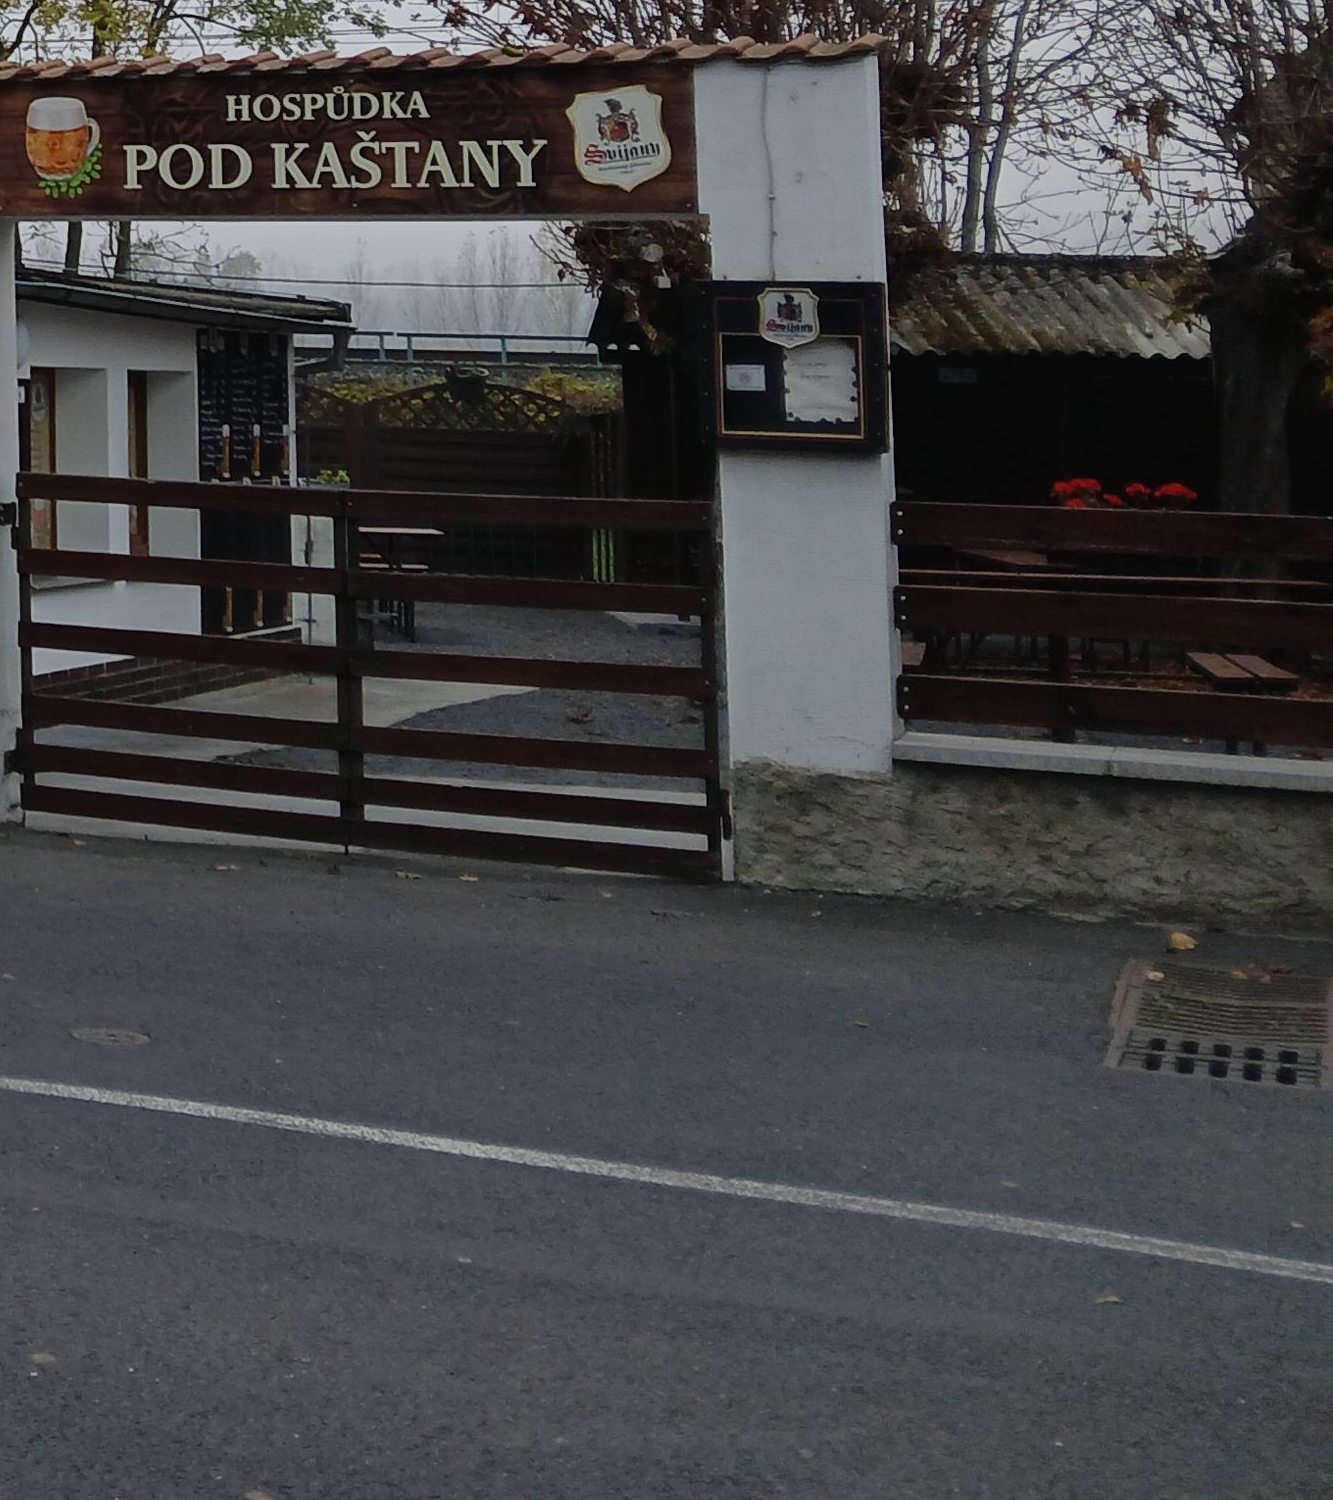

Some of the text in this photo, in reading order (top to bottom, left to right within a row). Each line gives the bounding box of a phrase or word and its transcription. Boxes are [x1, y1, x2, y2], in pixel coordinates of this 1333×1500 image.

[225, 86, 431, 122] HOSPŮDKA
[123, 130, 548, 190] POD KAŠTANY
[584, 142, 660, 166] Svijany
